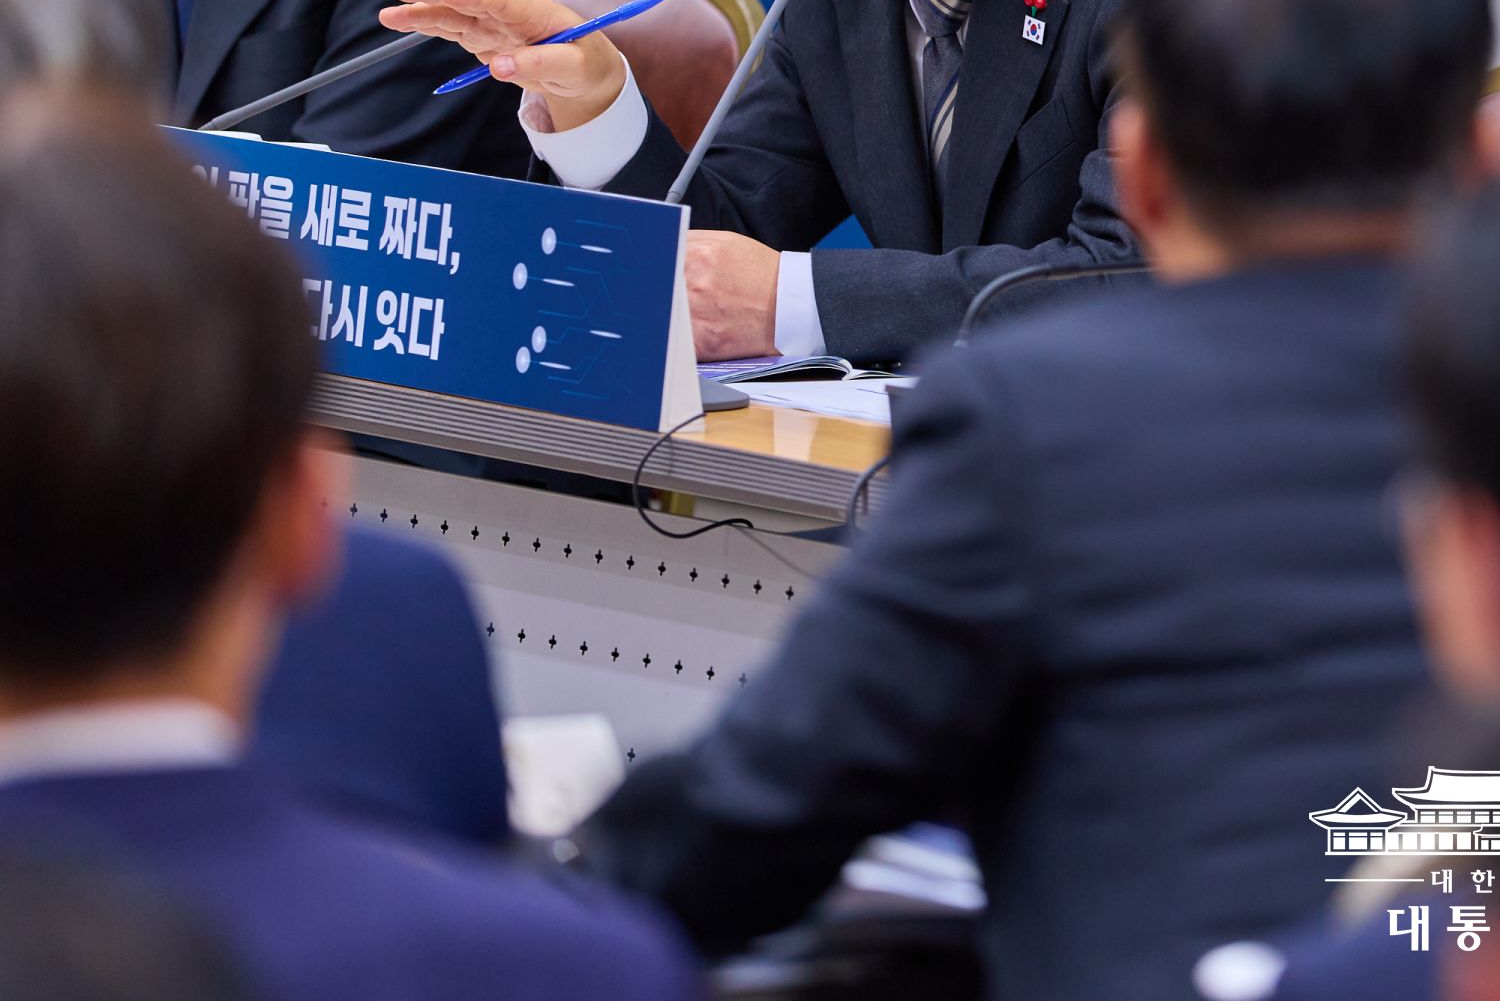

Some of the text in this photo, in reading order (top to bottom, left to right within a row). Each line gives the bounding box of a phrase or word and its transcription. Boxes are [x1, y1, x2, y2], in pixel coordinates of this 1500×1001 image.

[300, 184, 372, 251] 새로
[379, 195, 461, 275] 짜다,
[302, 278, 445, 361] 다시 잇다
